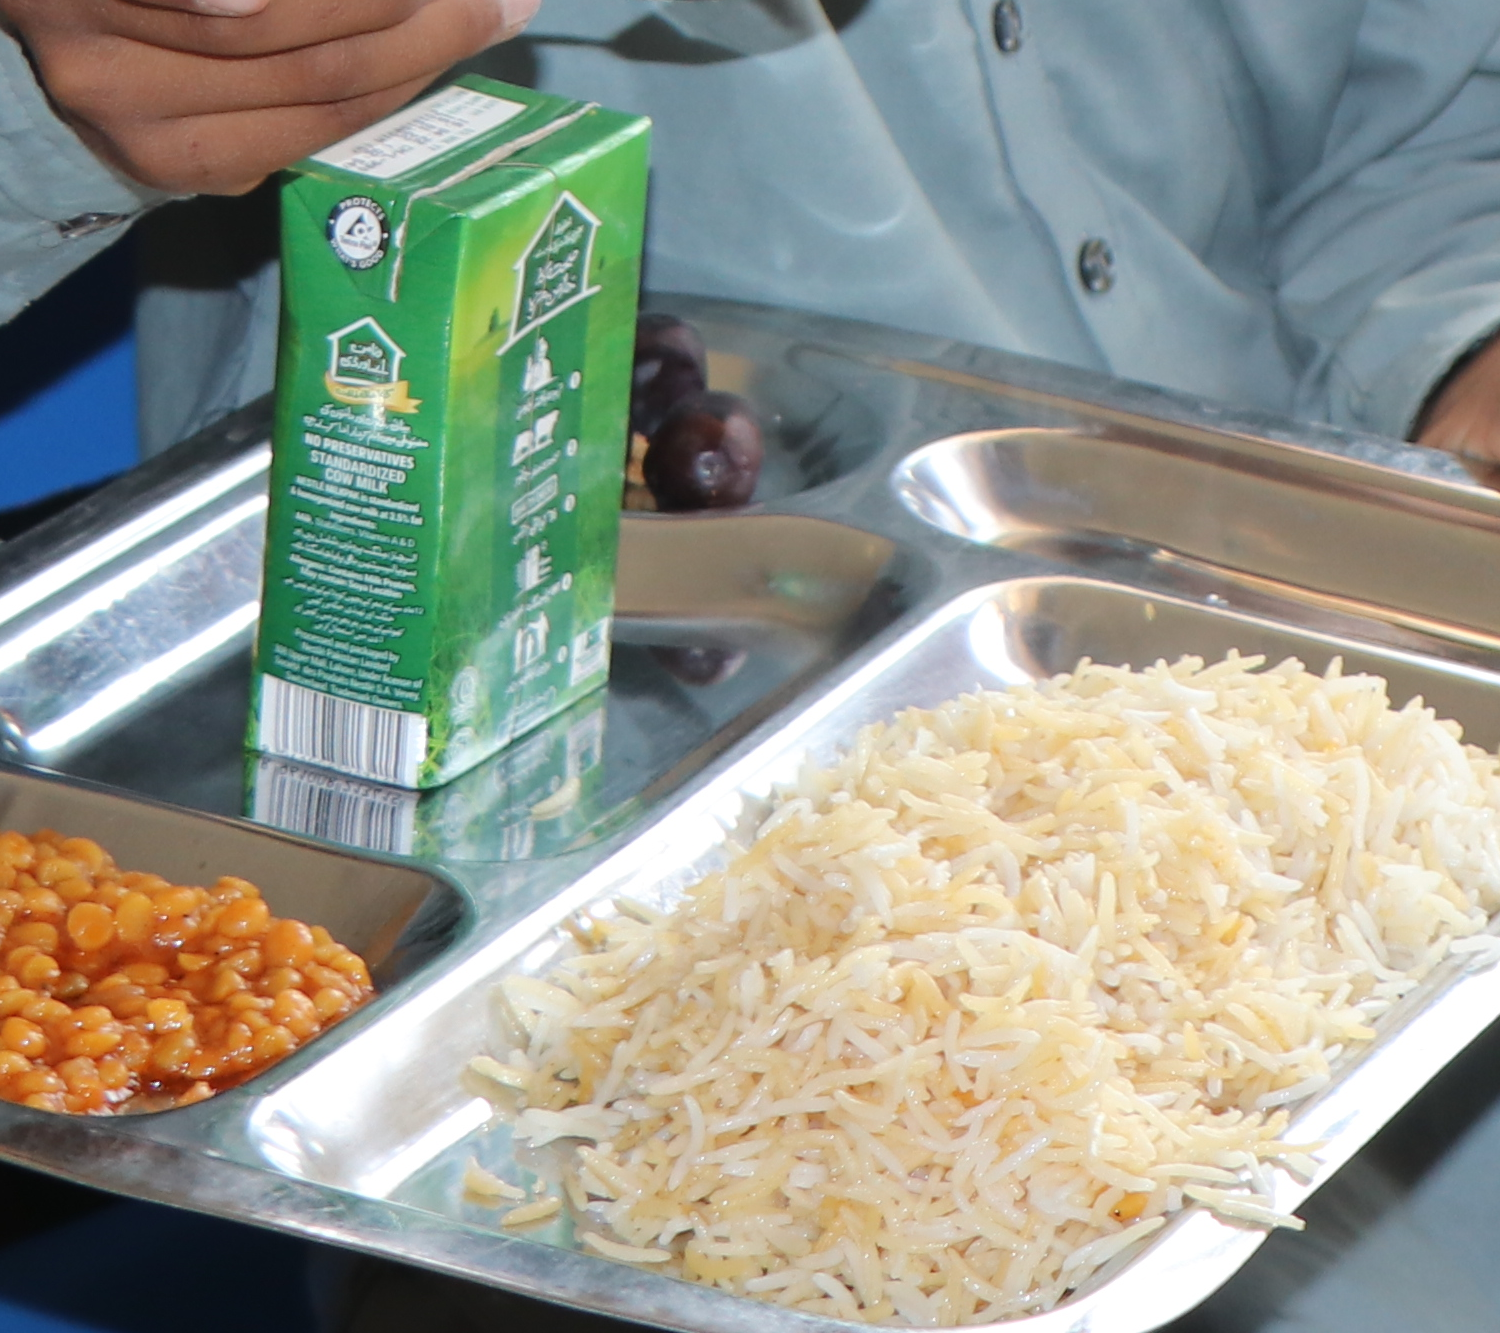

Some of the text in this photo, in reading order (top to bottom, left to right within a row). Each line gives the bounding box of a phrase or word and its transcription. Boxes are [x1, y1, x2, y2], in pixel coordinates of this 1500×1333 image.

[339, 197, 386, 220] PROTECTS
[330, 237, 385, 269] WHAT'S GOOD
[304, 432, 414, 469] NO PRESERVATIVES
[310, 449, 406, 484] STANDARDIZED
[324, 468, 388, 494] COW MILK
[390, 535, 398, 544] A
[399, 537, 406, 546] &
[407, 539, 415, 548] D
